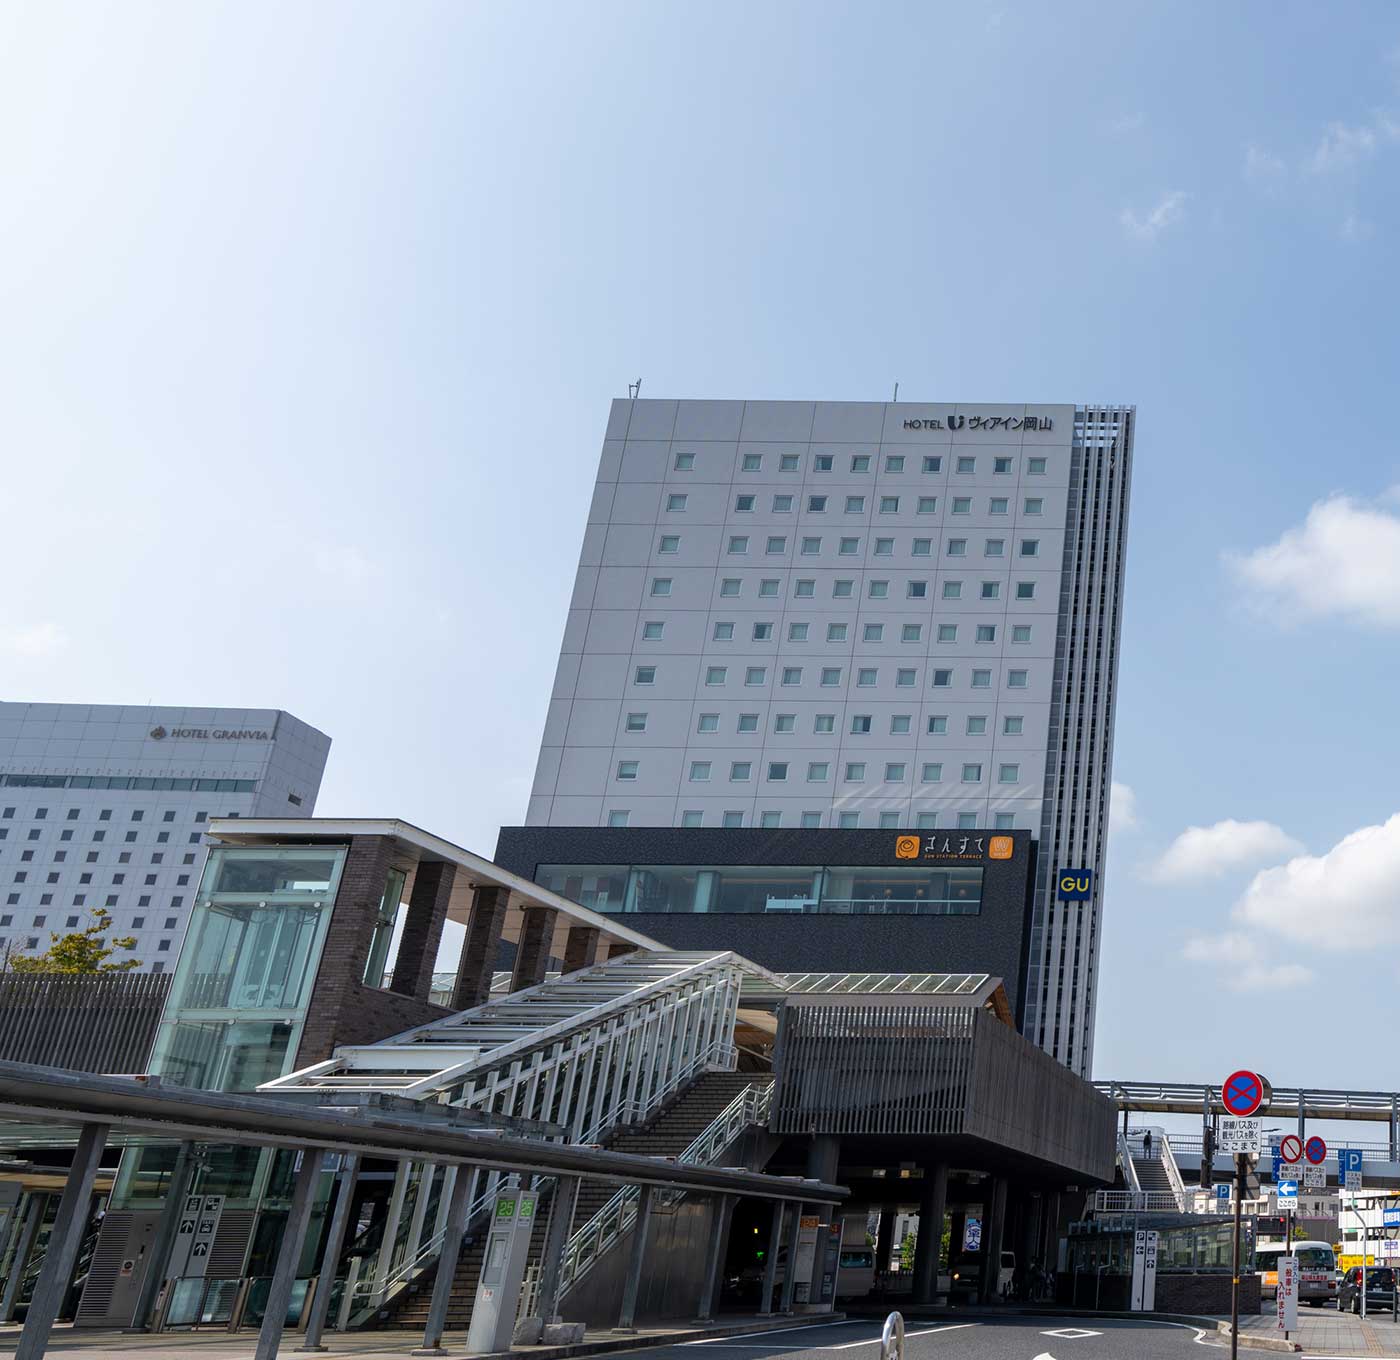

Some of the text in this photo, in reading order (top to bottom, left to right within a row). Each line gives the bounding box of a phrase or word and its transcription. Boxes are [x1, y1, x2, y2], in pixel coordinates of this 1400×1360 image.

[903, 416, 1053, 430] HOTEL ヴィアイン岡山
[171, 728, 268, 740] HOTEL GRANVIA
[924, 836, 984, 854] さんすて
[1060, 877, 1089, 892] GU
[1223, 1121, 1258, 1129] 路線バス及び
[1222, 1142, 1258, 1150] ここまで
[499, 1202, 514, 1216] 25
[521, 1202, 533, 1216] 25
